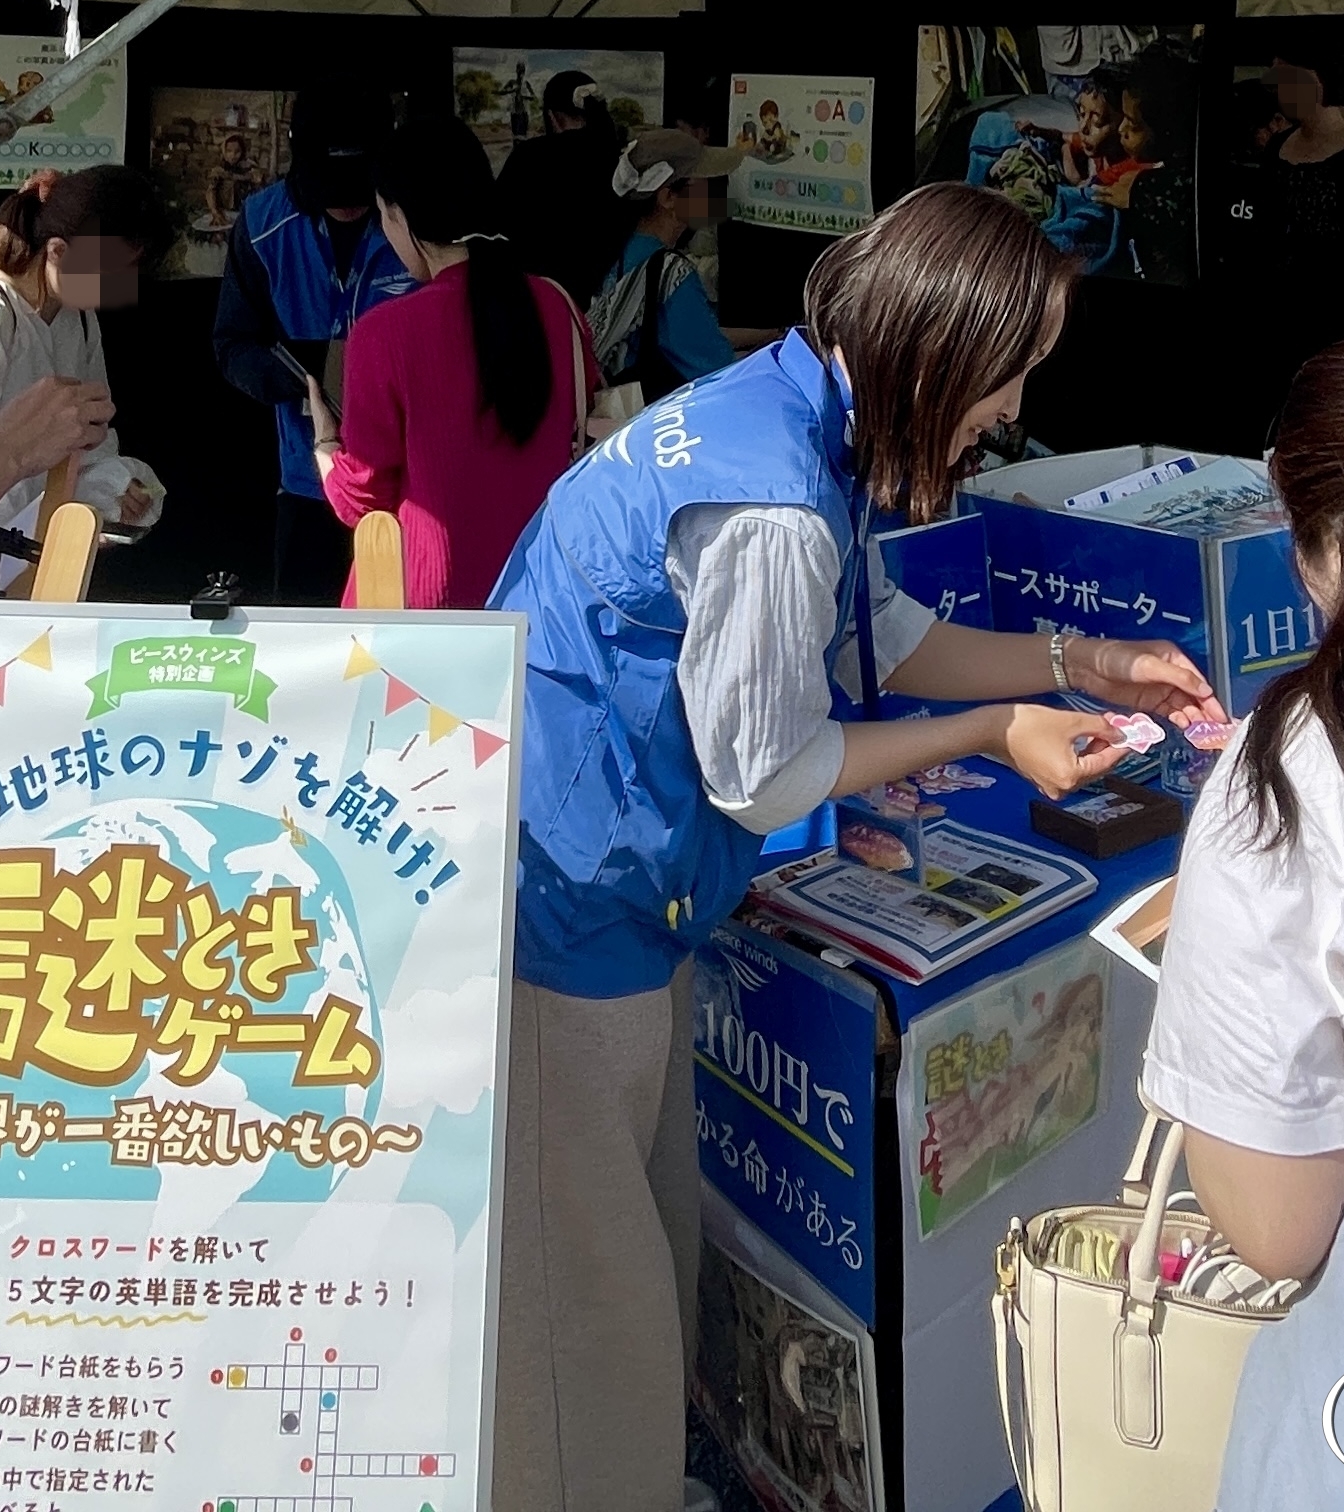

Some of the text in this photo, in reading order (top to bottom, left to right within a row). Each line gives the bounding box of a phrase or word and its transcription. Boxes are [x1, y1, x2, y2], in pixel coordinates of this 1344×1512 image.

[832, 99, 845, 121] A
[986, 556, 1191, 625] ースサポーター
[130, 643, 246, 665] ピースウィンズ
[148, 664, 215, 684] 特別企画
[744, 943, 779, 975] winds
[155, 996, 373, 1079] ゲーム
[702, 1001, 855, 1151] 100円で
[11, 1235, 270, 1264] クロスワードを解いて
